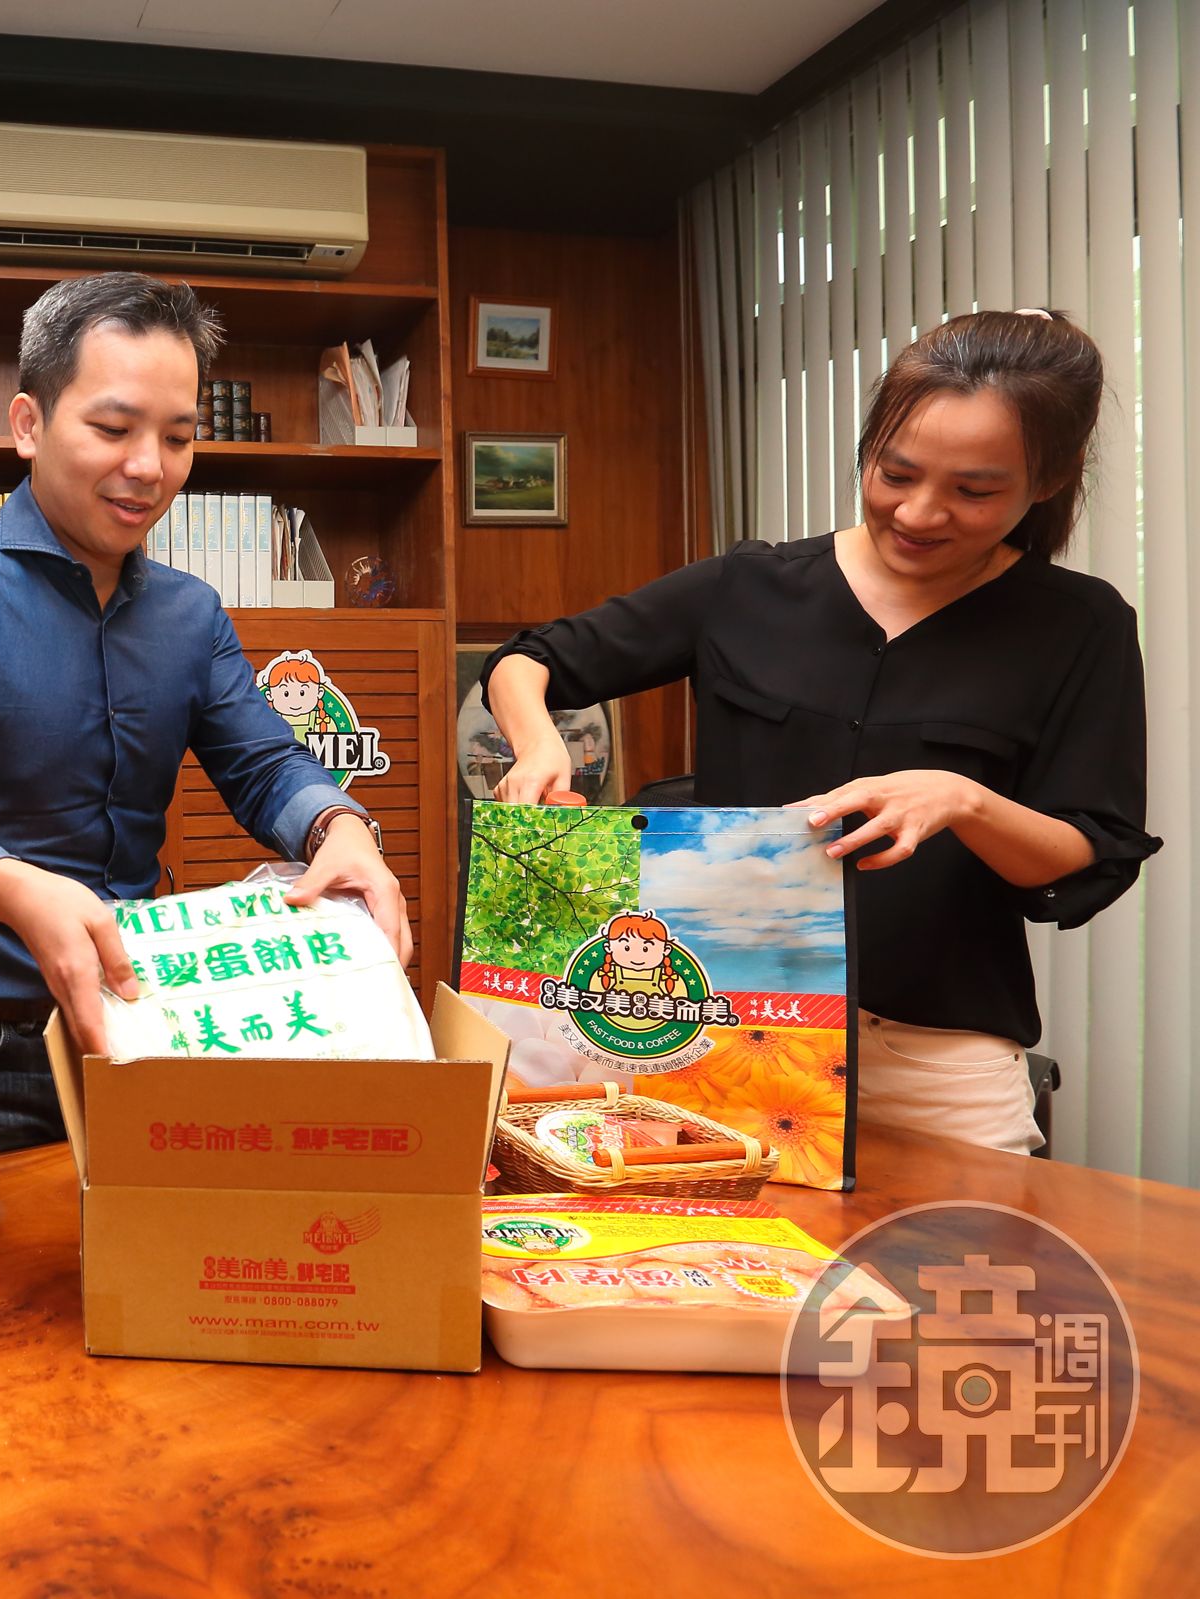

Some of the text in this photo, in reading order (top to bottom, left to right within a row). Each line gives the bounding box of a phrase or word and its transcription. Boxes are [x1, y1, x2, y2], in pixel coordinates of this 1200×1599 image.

[306, 733, 374, 769] MEI
[115, 900, 194, 935] MEI
[203, 909, 223, 926] &
[490, 972, 530, 997] 美而美
[193, 989, 333, 1053] 美而美
[586, 1019, 682, 1050] FAST-FOOD & COFFEE
[169, 1121, 274, 1151] 美而美
[291, 1127, 409, 1151] 鮮宅配
[217, 1256, 289, 1281] 美而美
[297, 1262, 350, 1283] 鮮宅配
[512, 1266, 685, 1288] 漢堡肉
[263, 1296, 338, 1308] 0800-088079
[188, 1315, 380, 1332] www.mam.com.tw
